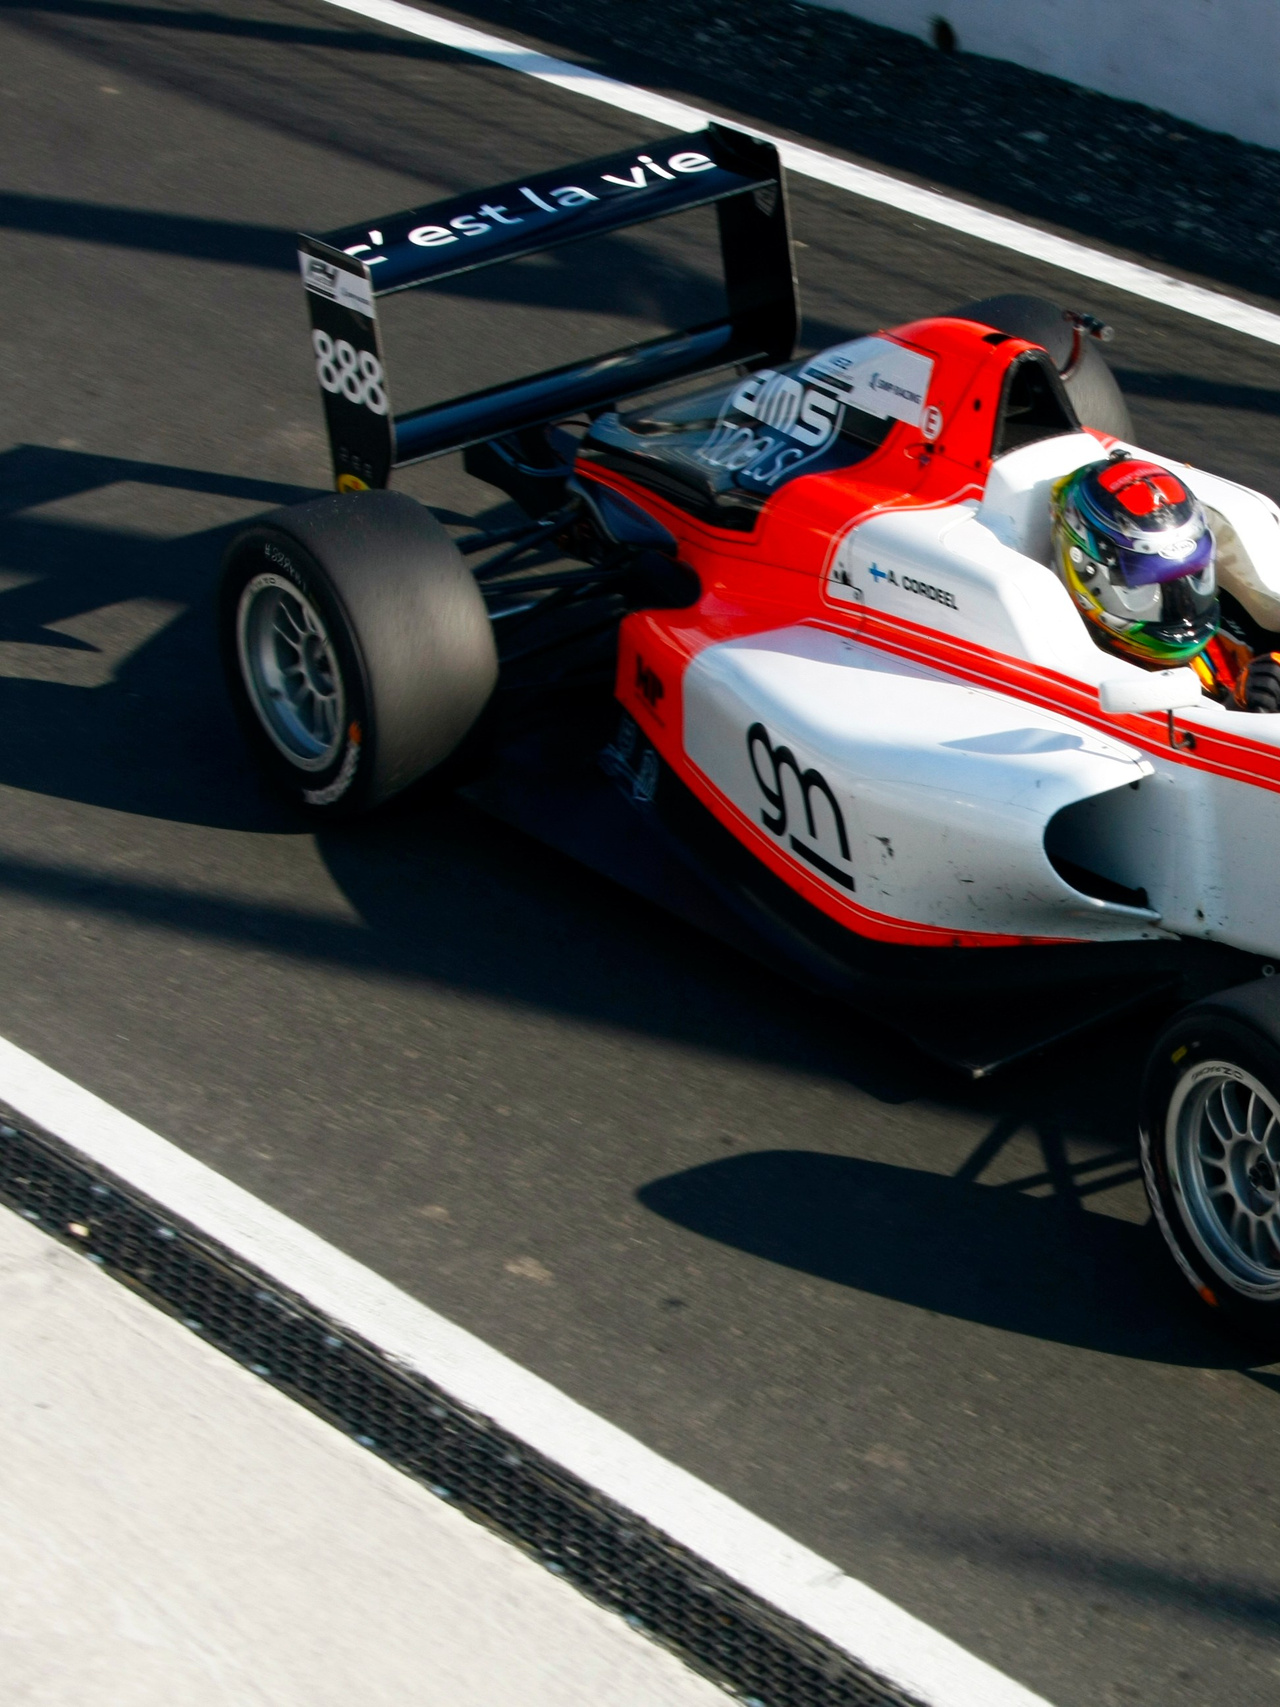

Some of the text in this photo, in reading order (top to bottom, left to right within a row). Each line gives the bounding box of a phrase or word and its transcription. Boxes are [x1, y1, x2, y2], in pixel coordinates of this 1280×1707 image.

[408, 203, 524, 248] est
[519, 186, 600, 213] la
[601, 151, 718, 189] vie
[312, 328, 390, 416] 888
[925, 406, 938, 434] E
[902, 575, 959, 610] CORDEEL
